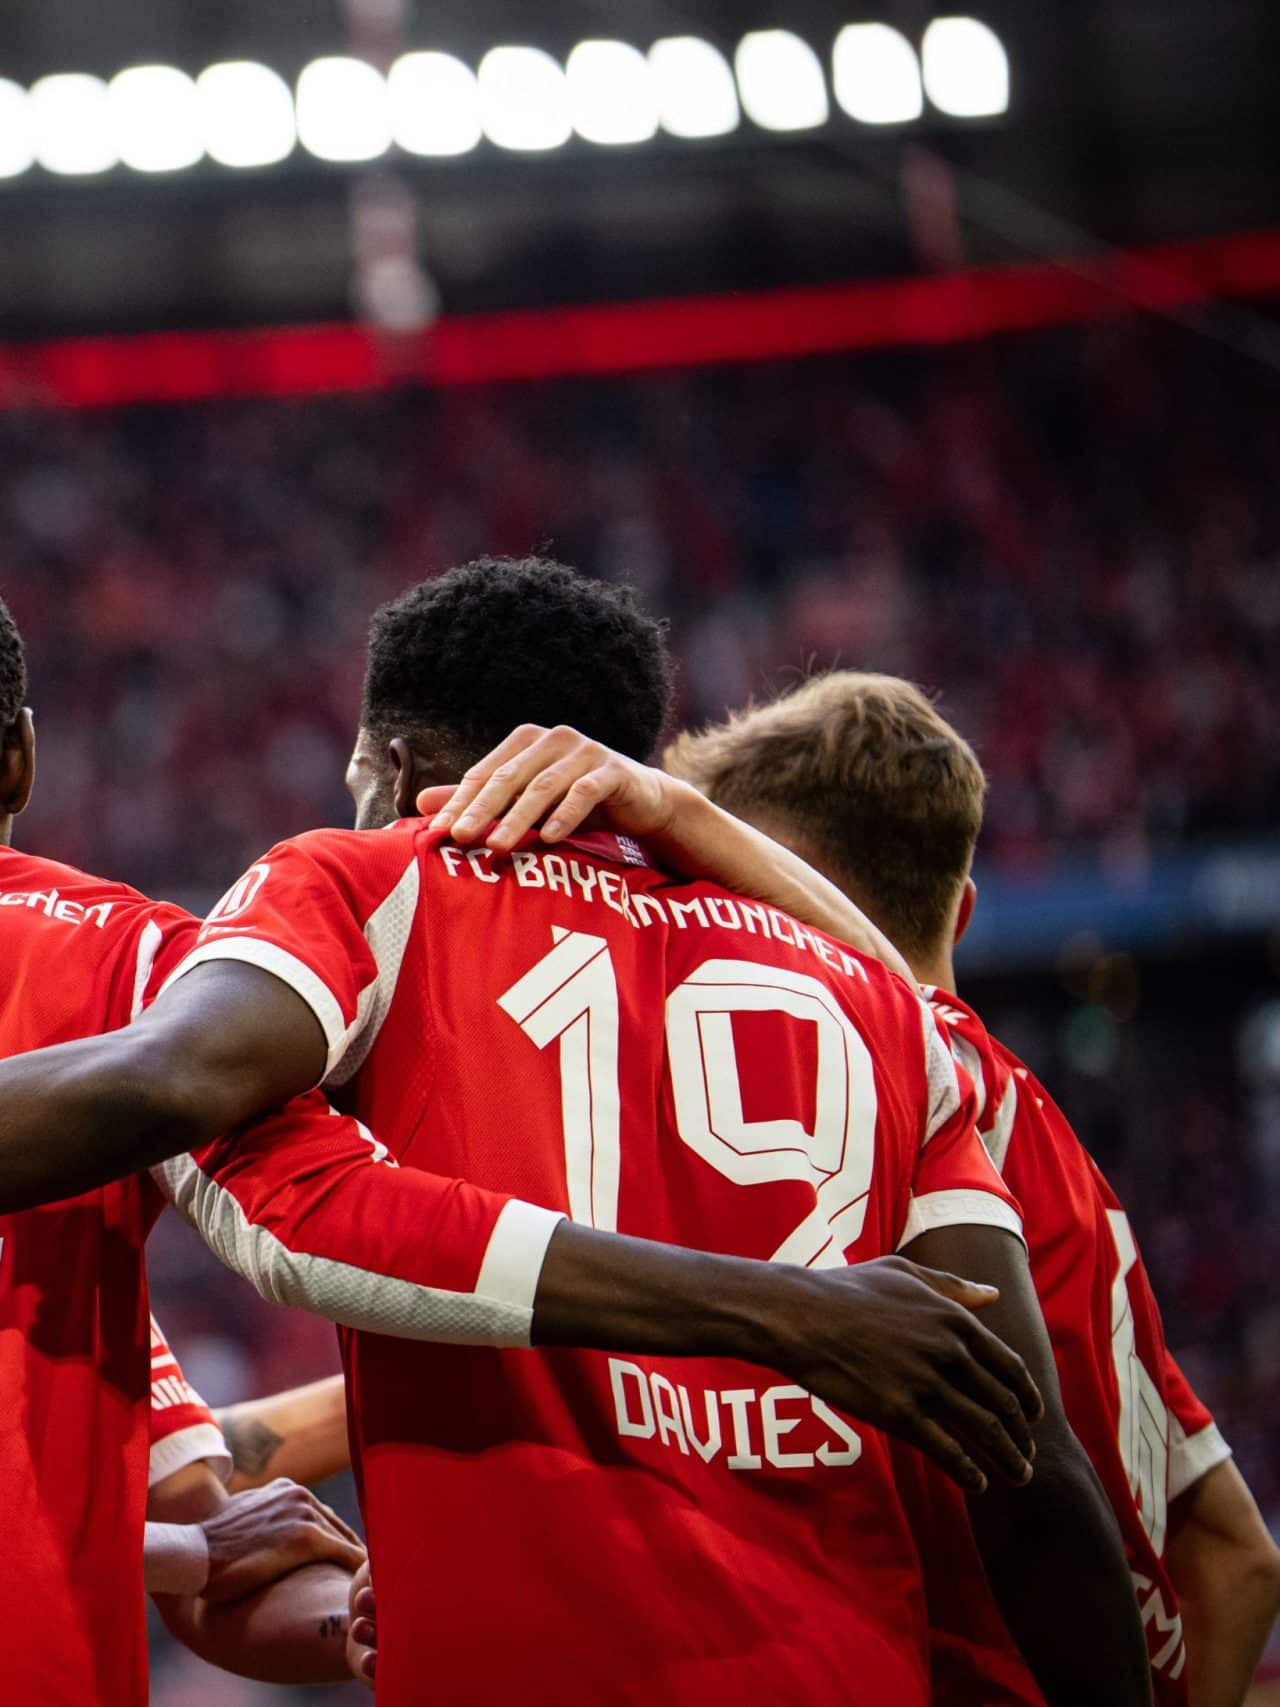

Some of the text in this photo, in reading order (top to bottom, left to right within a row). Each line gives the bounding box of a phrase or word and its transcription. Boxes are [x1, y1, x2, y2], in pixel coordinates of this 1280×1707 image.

[440, 846, 870, 985] FC BAYERN MÜNCHEN
[496, 926, 878, 1268] 19
[608, 1357, 862, 1470] DAVIES
